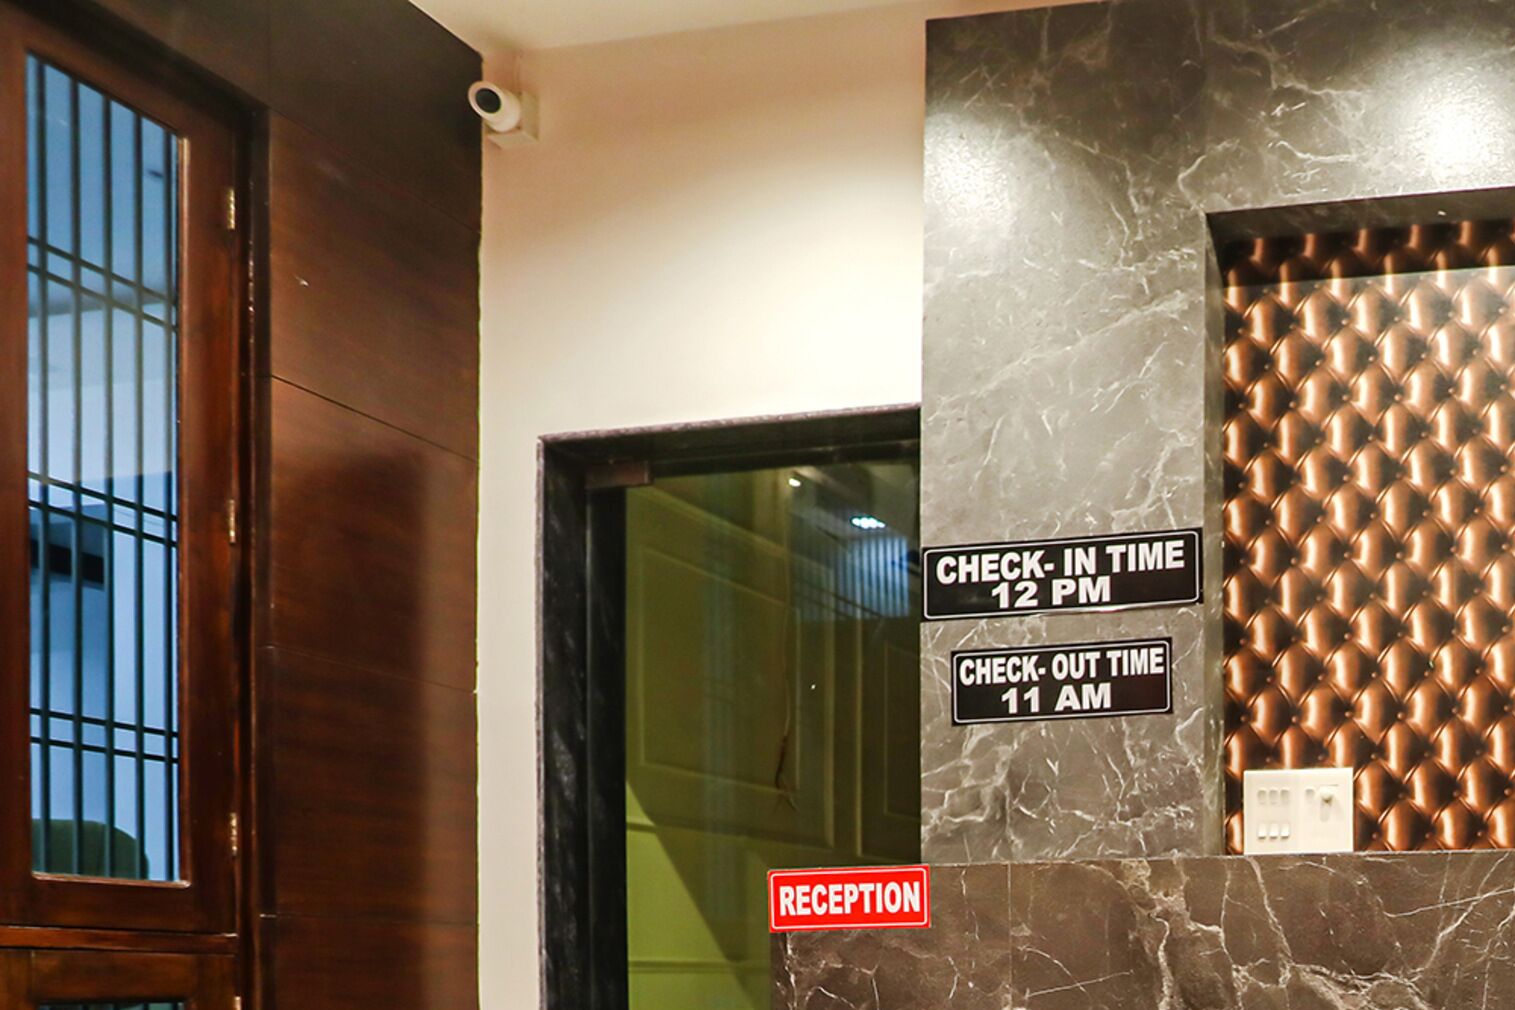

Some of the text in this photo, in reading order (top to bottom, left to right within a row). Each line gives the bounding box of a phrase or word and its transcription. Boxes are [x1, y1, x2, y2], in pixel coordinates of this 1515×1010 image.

[936, 540, 1185, 584] CHECK- IN TIME
[991, 576, 1111, 609] 12 PM
[959, 647, 1165, 686] CHECK- OUT TIME
[1000, 682, 1111, 714] 11 AM
[779, 881, 921, 916] RECEPTION
